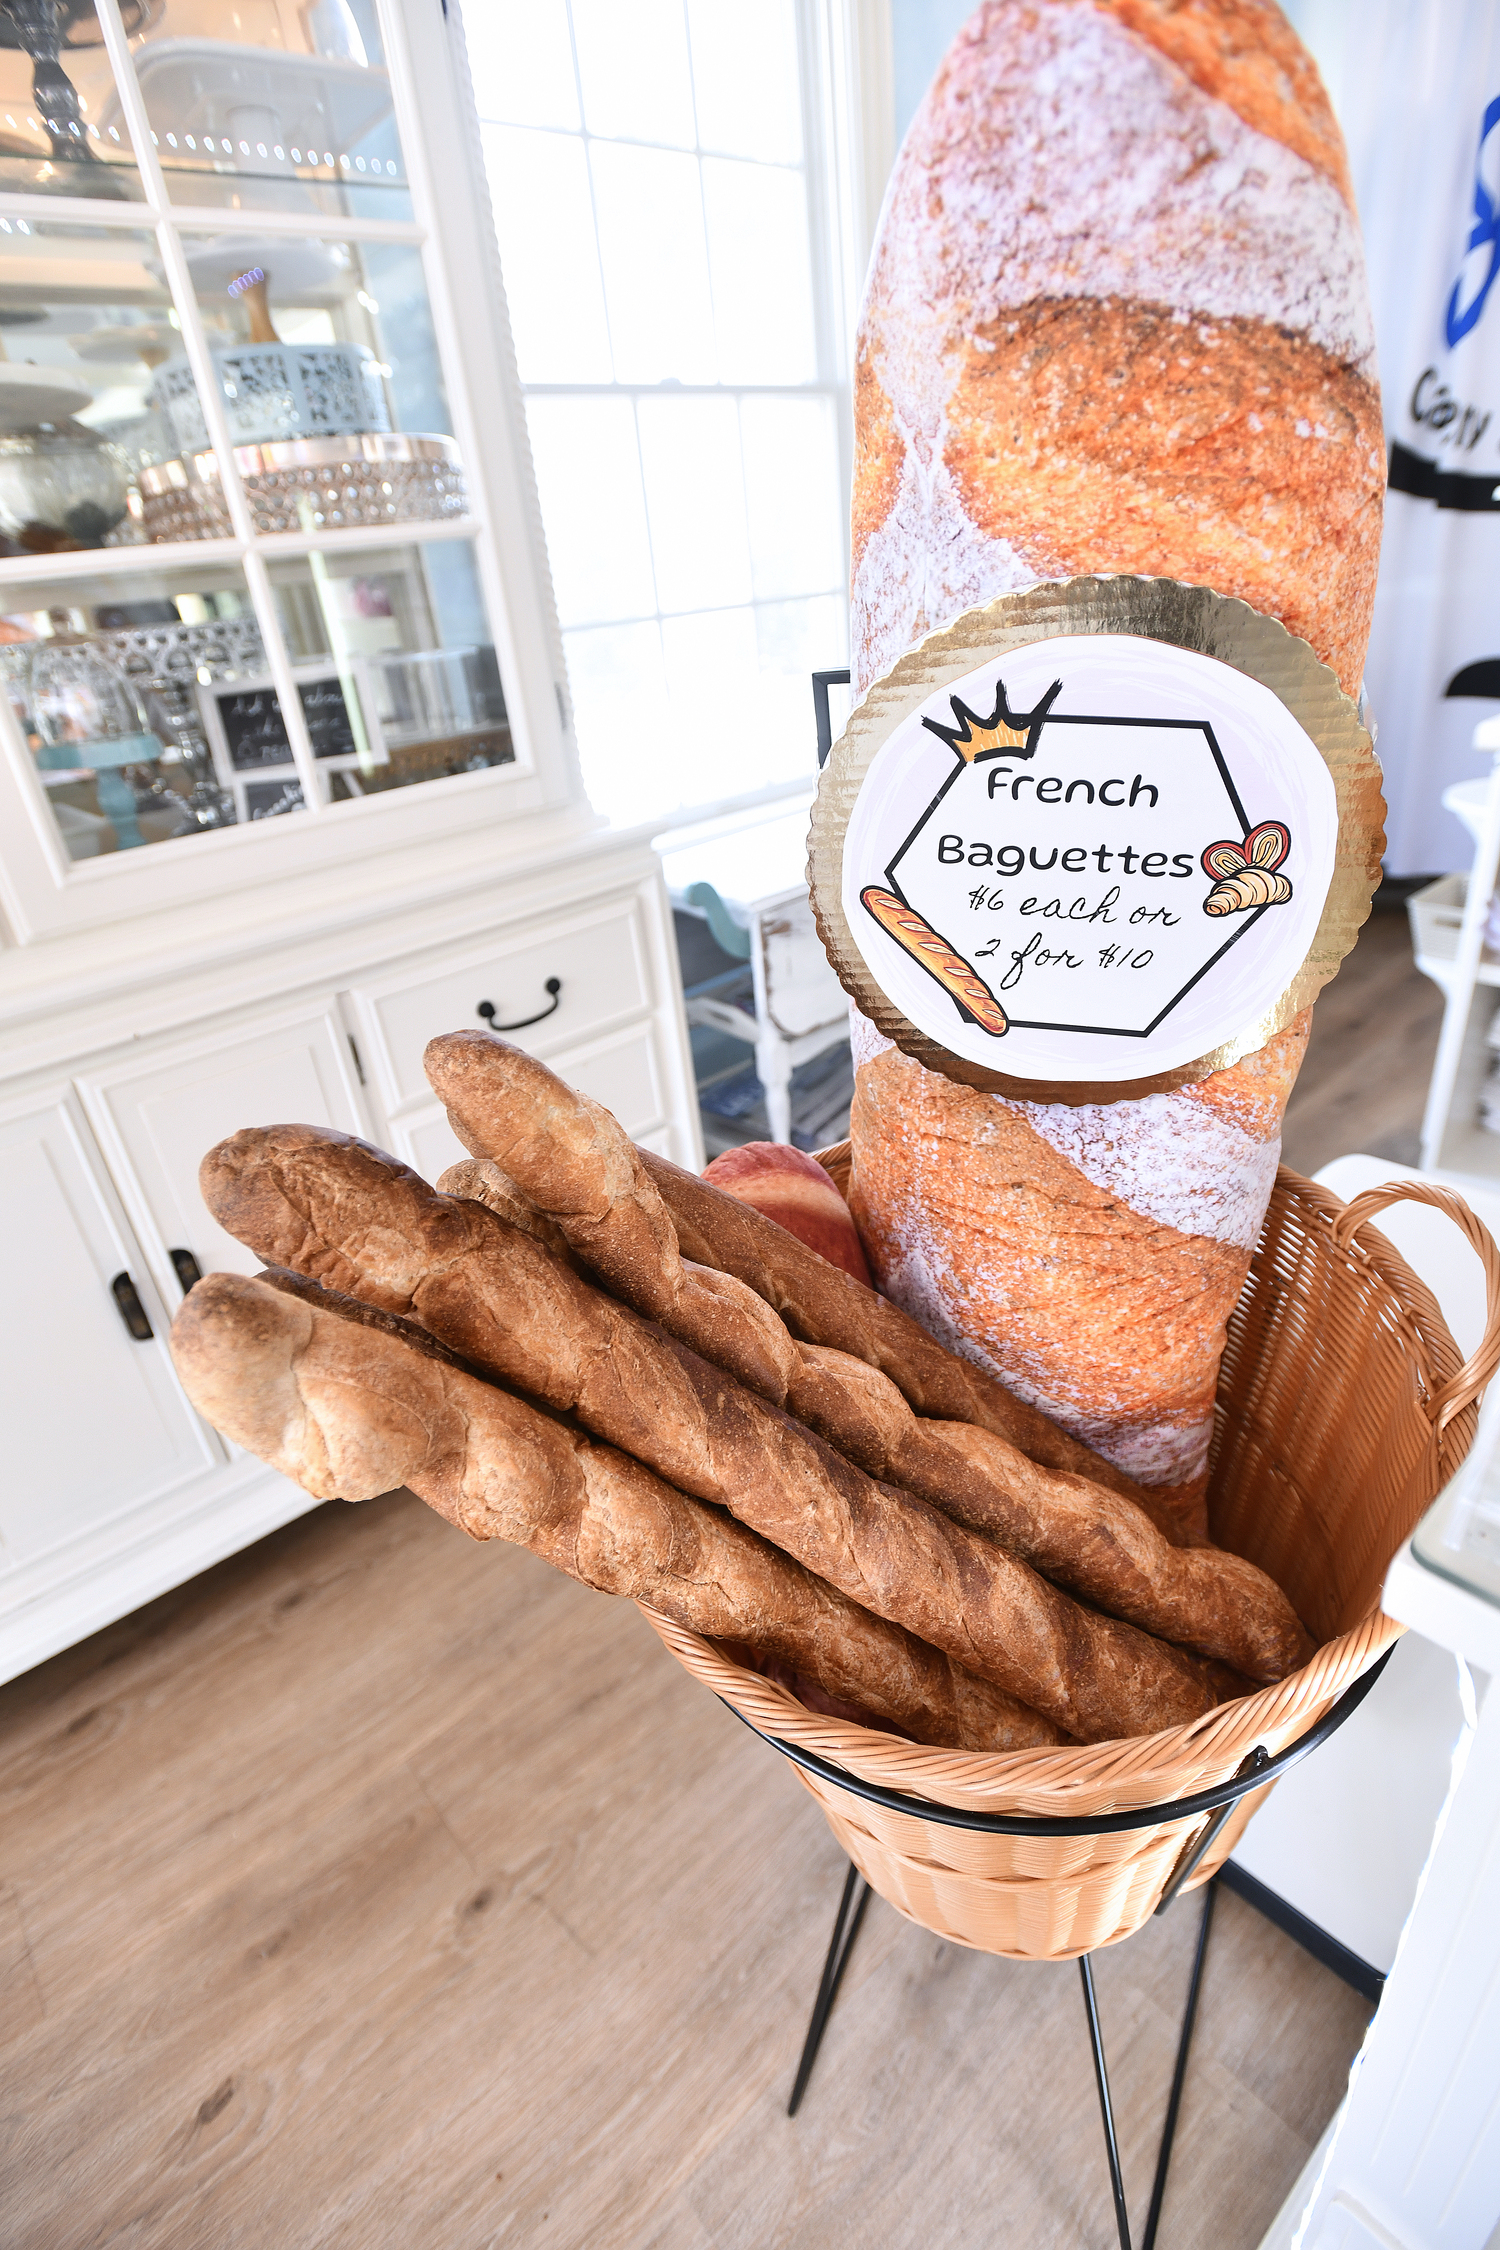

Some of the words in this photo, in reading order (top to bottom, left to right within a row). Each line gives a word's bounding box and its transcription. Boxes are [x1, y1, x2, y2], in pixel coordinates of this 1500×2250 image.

[986, 767, 1160, 808] French
[937, 834, 1194, 878] Baguettes
[968, 884, 1004, 912] $6
[1019, 885, 1121, 924] each
[1128, 905, 1182, 927] or
[974, 938, 1001, 957] 2
[1000, 931, 1085, 991] for
[1098, 943, 1154, 969] $10
